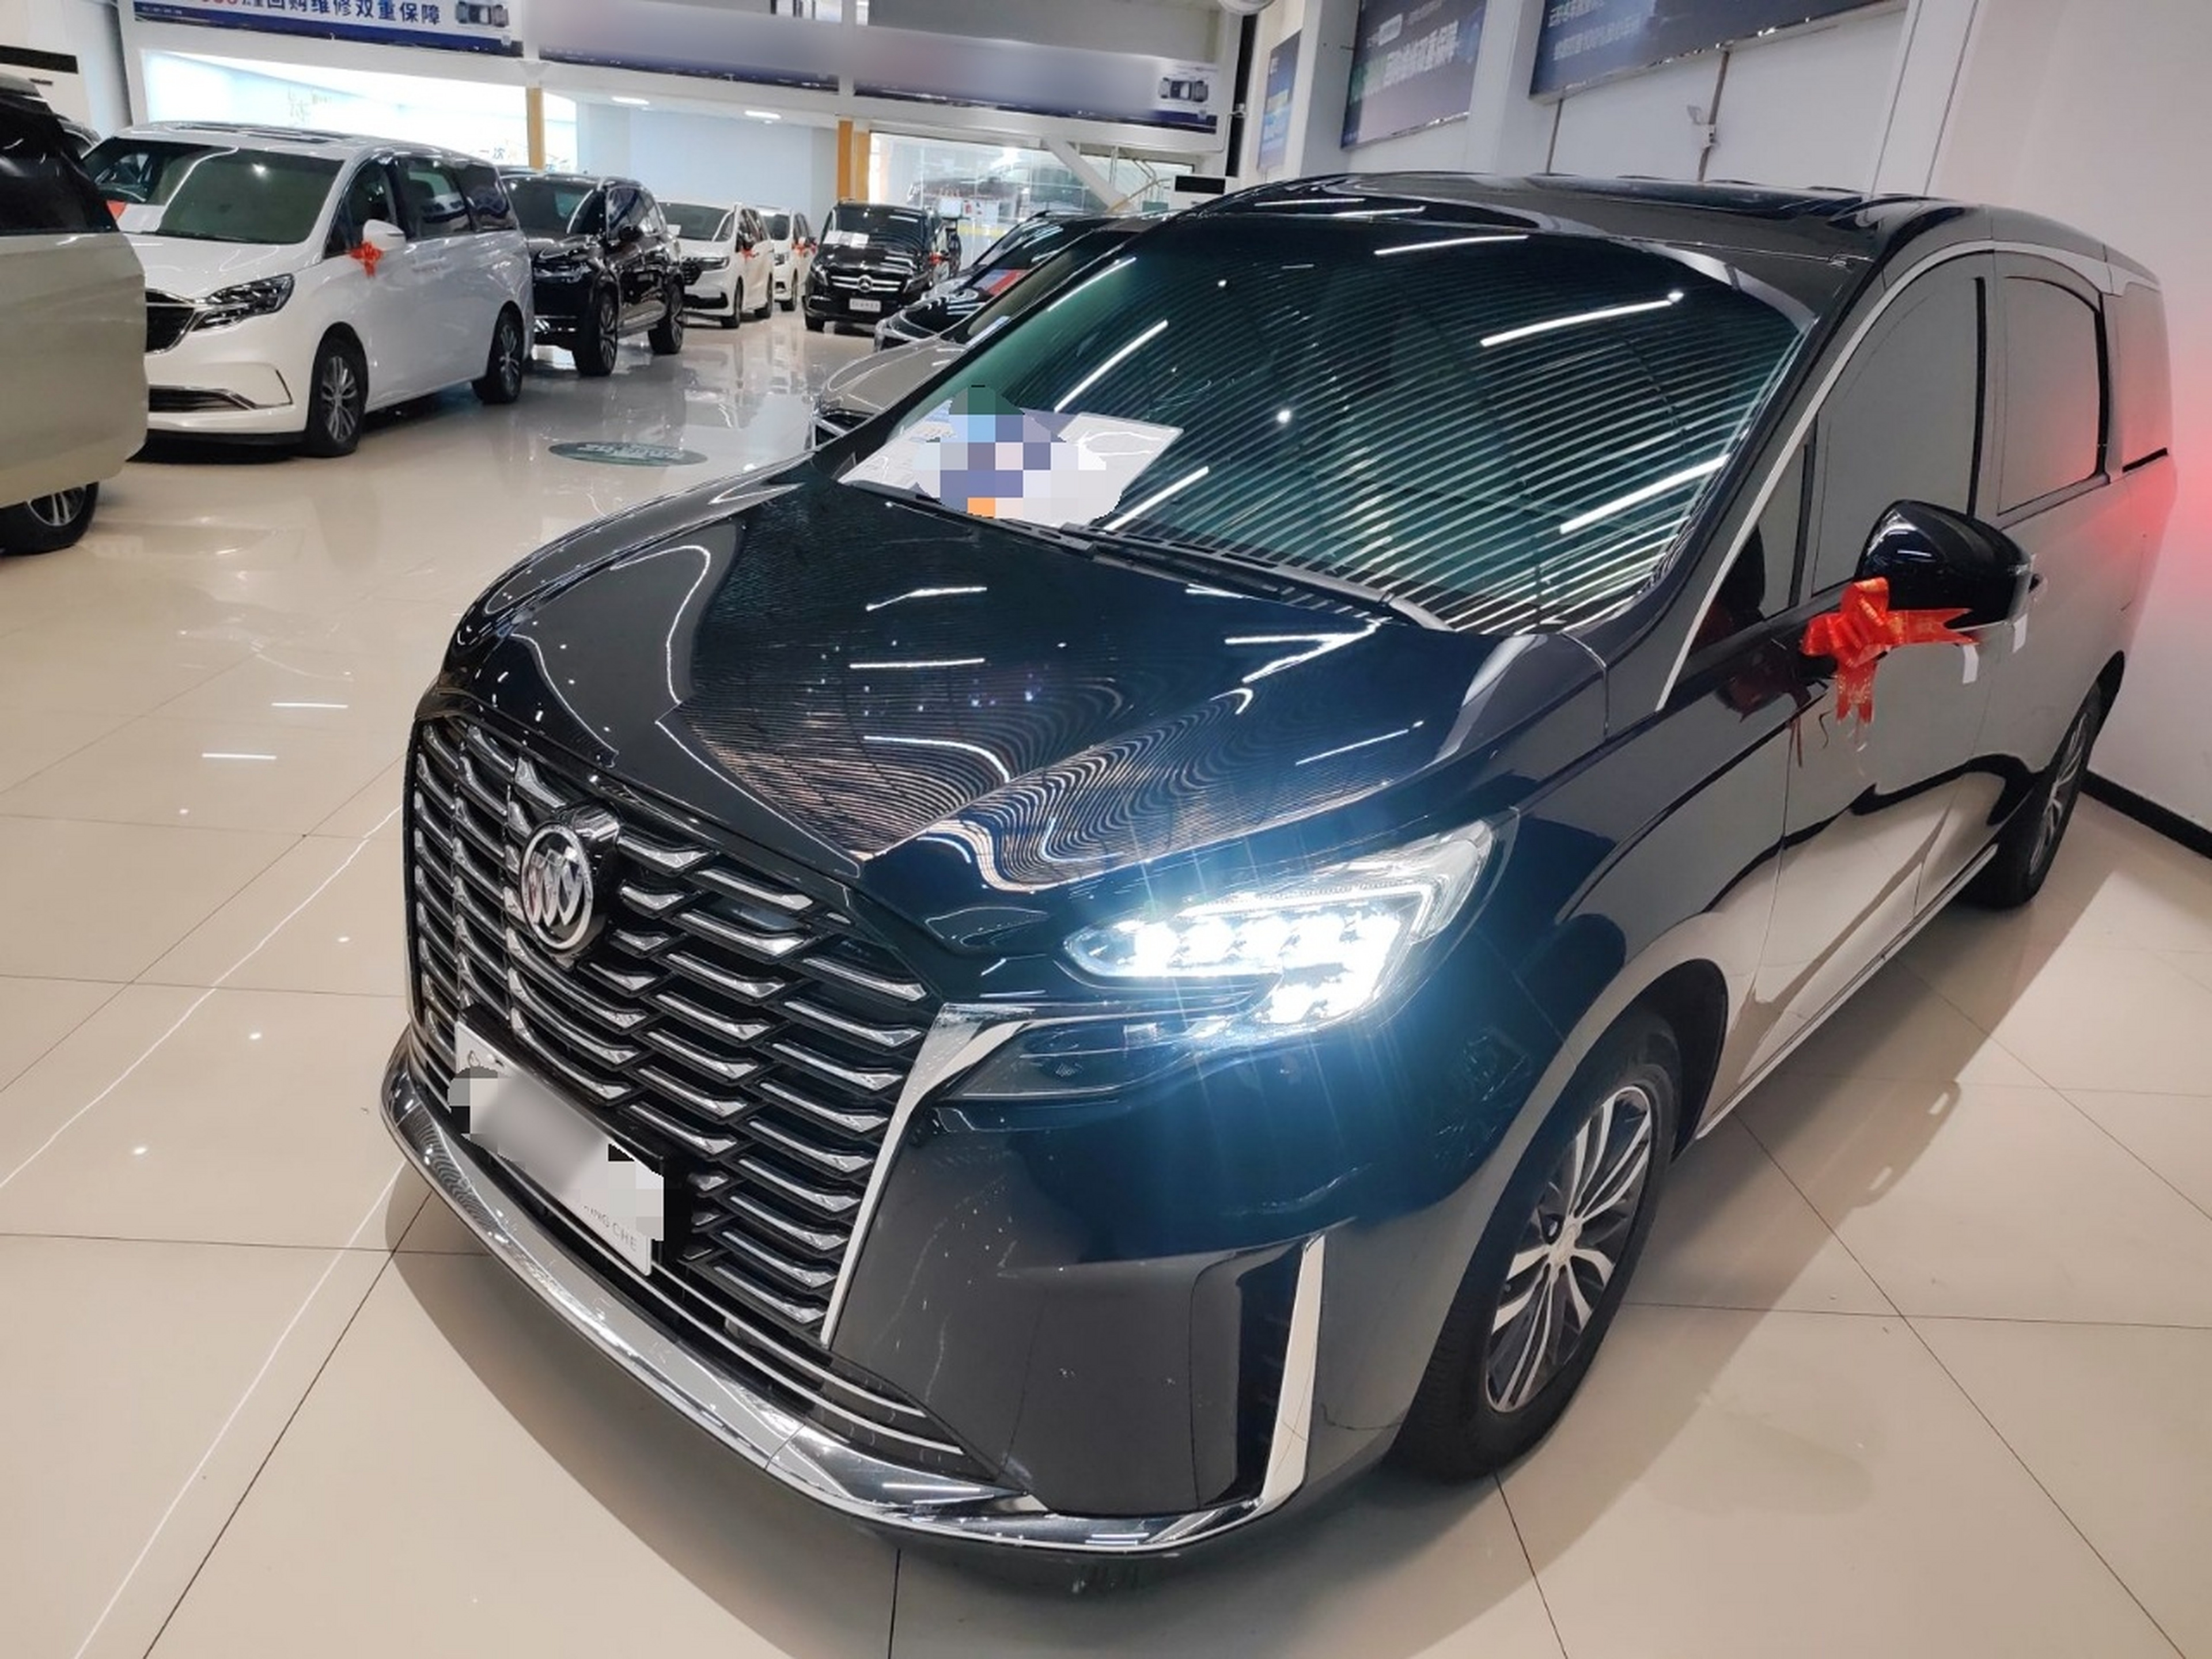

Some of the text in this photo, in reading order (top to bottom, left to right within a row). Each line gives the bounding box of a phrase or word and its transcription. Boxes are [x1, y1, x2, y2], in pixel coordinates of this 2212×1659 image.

[202, 0, 441, 25] 回购维修双重保障
